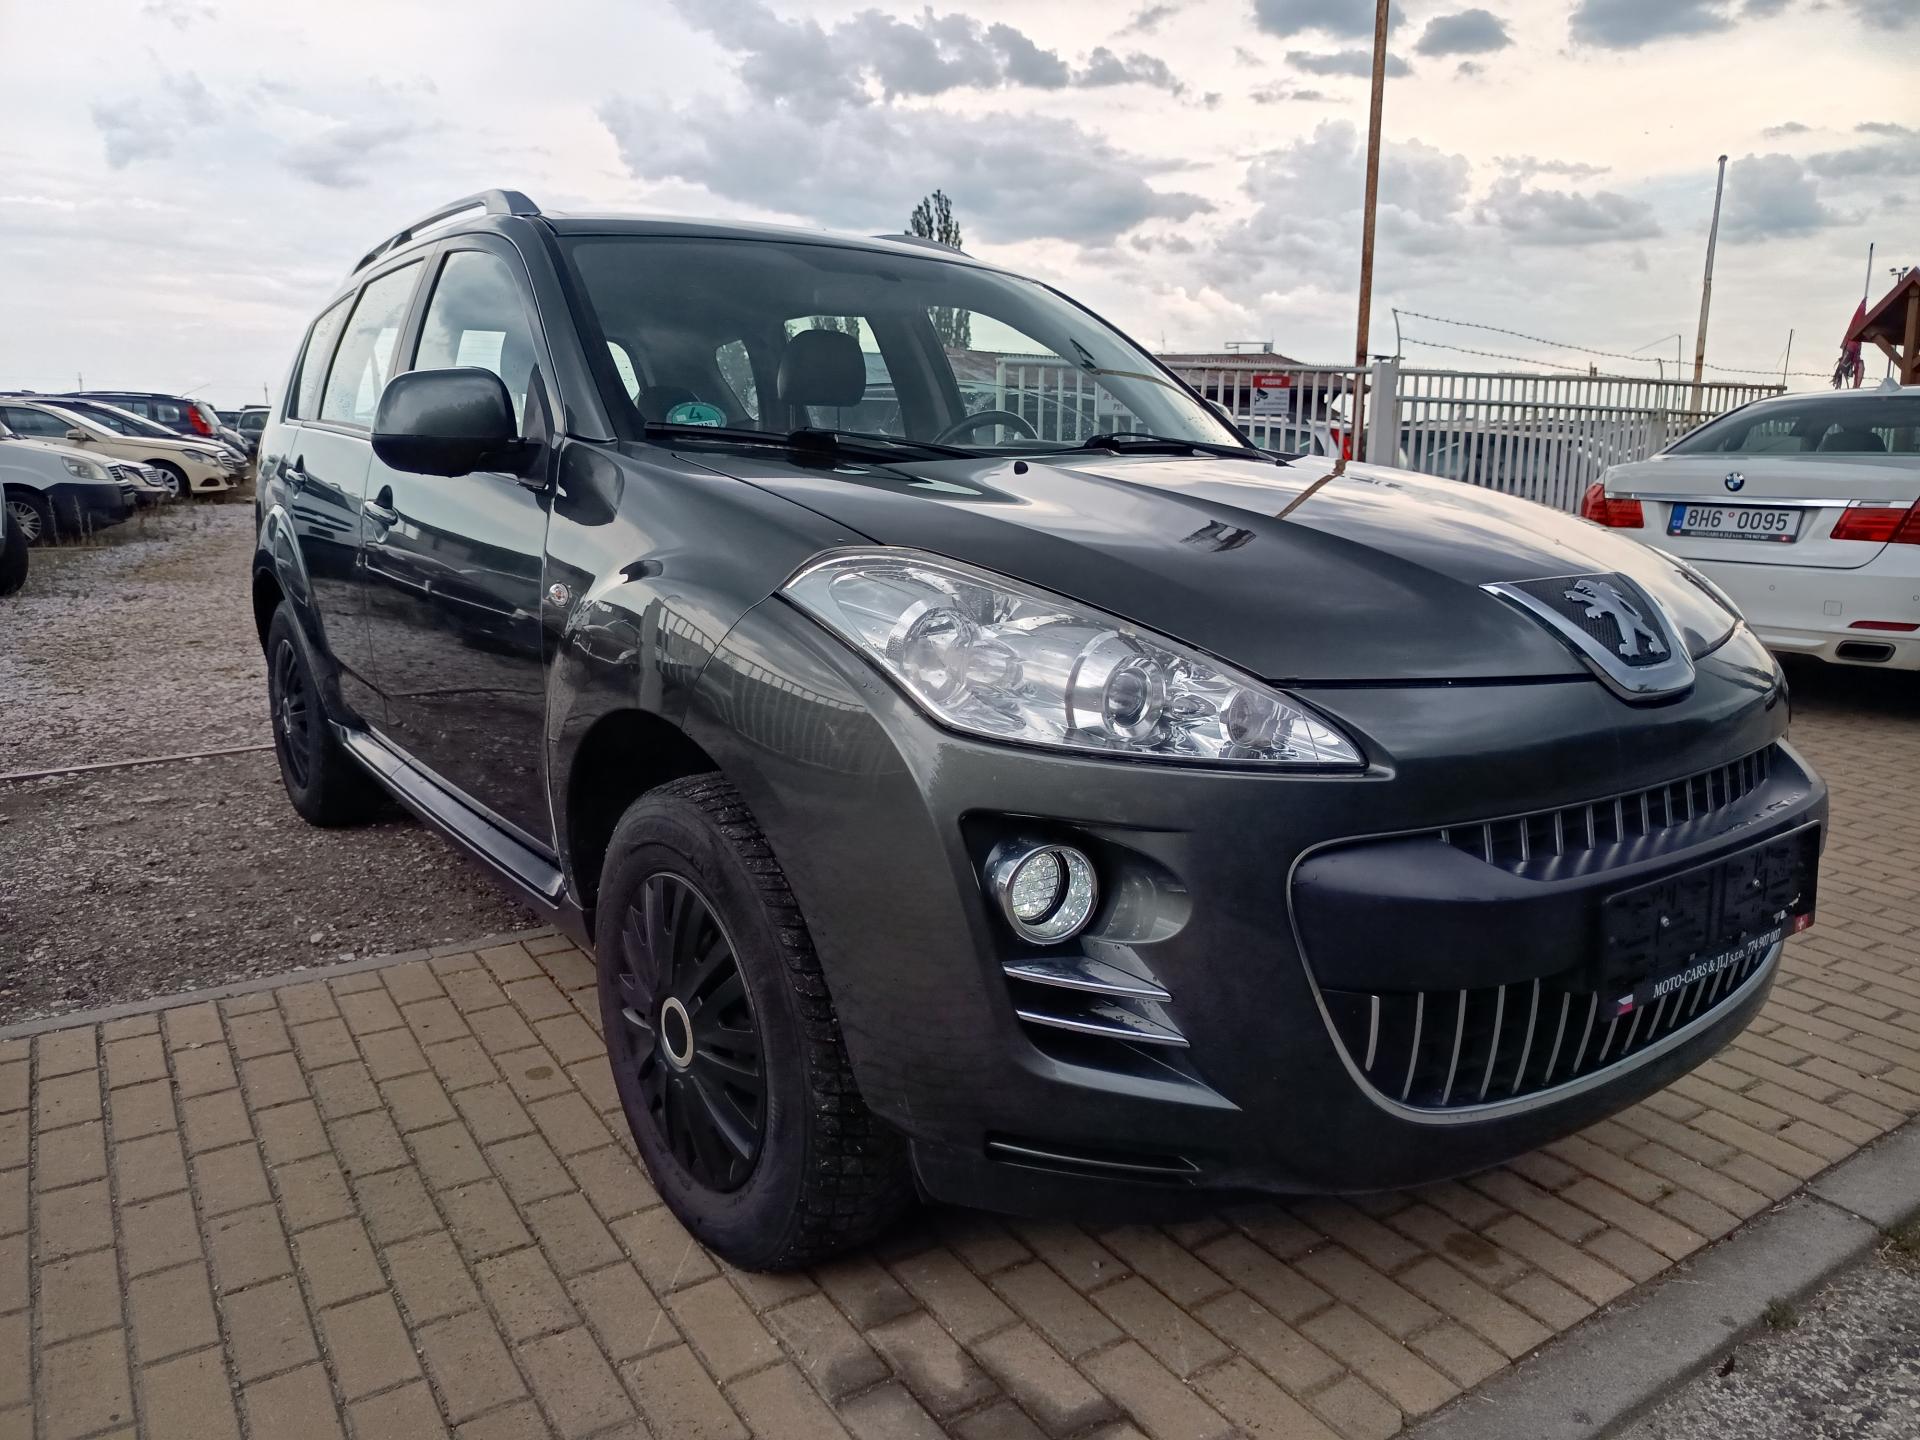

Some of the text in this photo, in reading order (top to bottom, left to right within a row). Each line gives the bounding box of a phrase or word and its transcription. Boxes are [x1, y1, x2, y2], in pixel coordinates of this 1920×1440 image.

[1687, 509, 1789, 531] 8H6 0095
[1653, 962, 1708, 998] MOTO-CARS
[1708, 959, 1716, 973] &
[1747, 938, 1759, 955] 774
